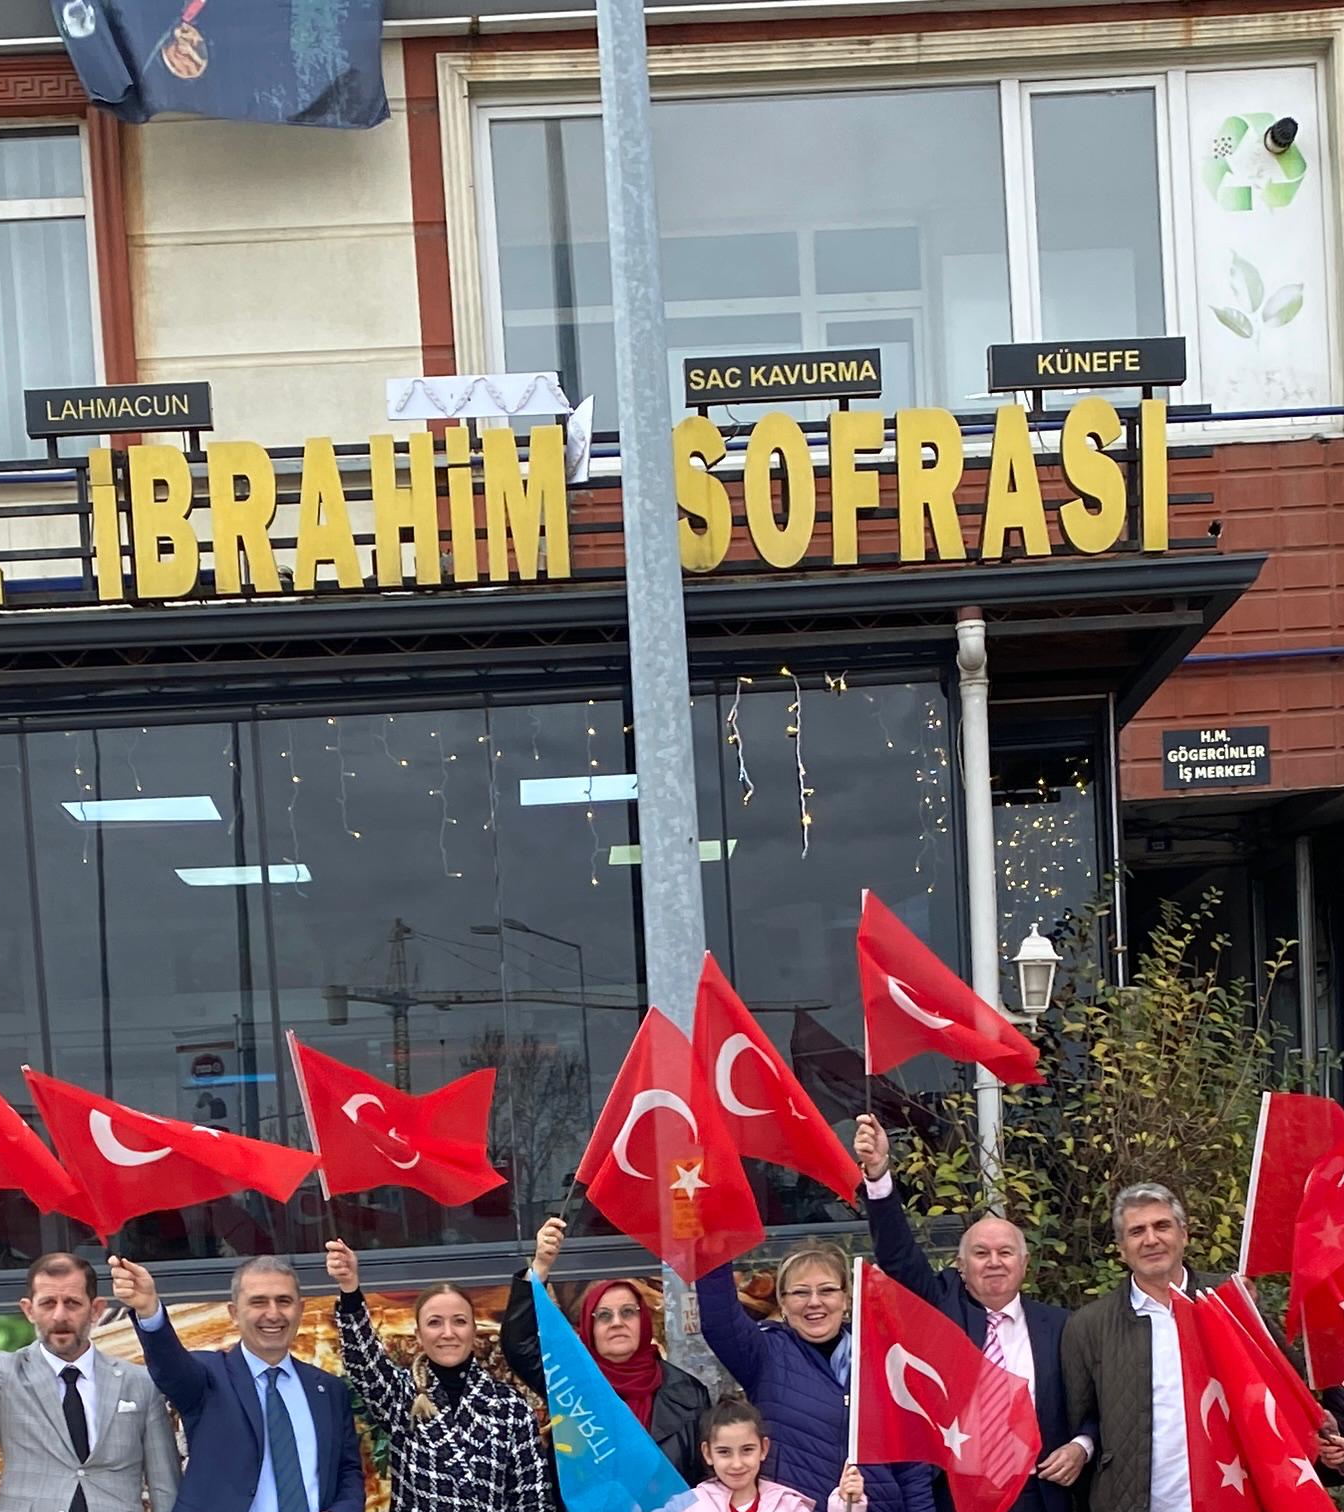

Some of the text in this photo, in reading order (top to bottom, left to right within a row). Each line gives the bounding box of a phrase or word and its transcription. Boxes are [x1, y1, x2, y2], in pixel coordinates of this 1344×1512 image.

[1037, 348, 1140, 375] KÜNEFE
[689, 360, 877, 391] SAC KAVURMA
[46, 393, 189, 421] LAHMACUN
[673, 396, 1169, 574] SOFRASI
[1200, 730, 1231, 743] H.M.
[1178, 760, 1256, 782] İŞ MERKEZİ
